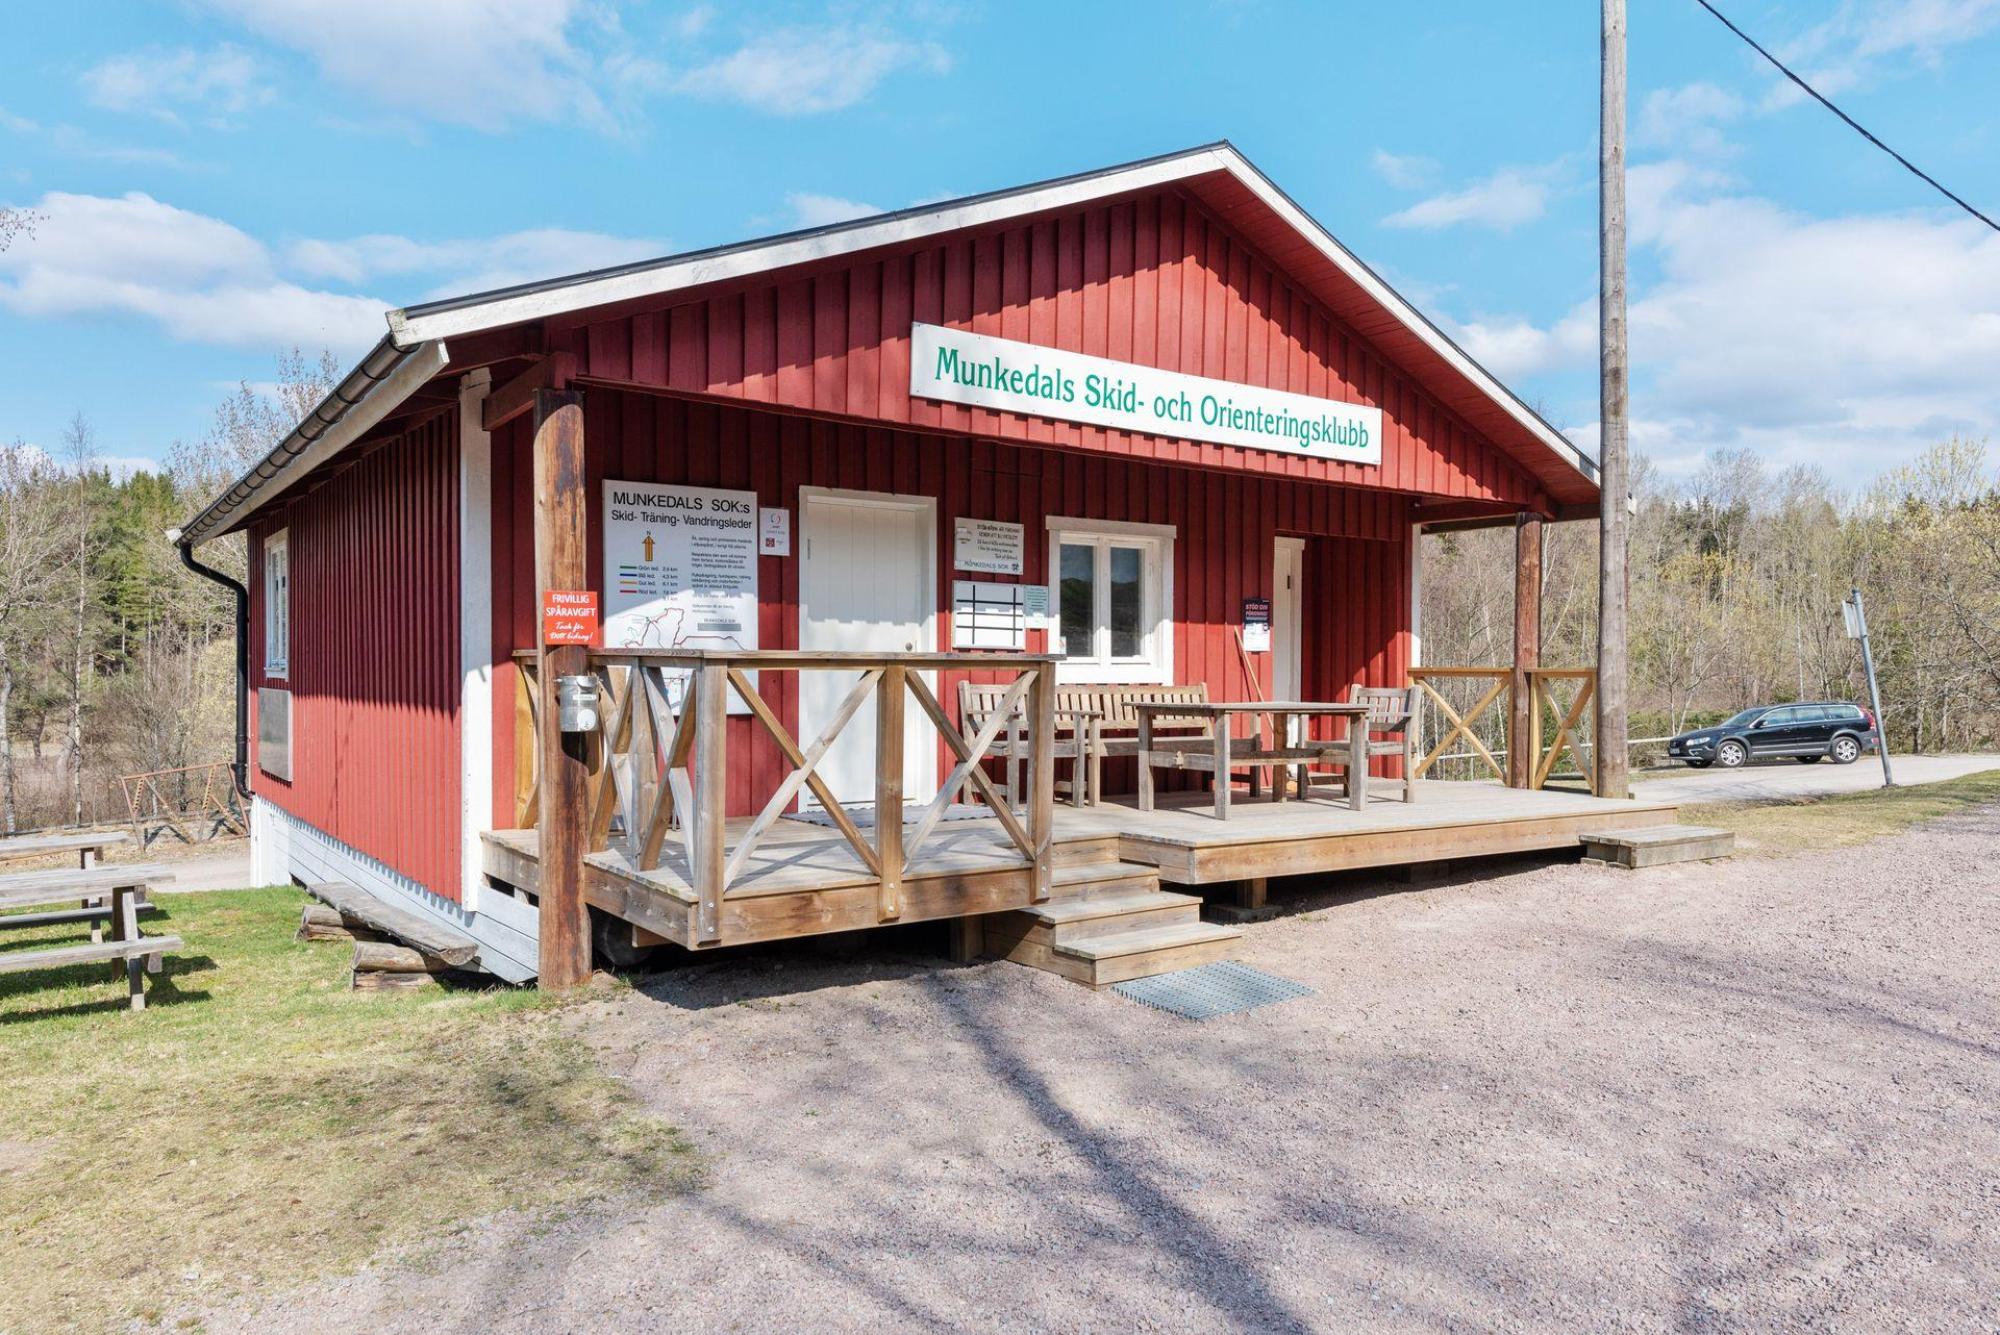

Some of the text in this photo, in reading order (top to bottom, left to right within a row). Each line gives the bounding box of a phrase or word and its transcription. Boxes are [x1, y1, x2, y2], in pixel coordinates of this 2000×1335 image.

[934, 346, 1369, 448] Munkedals Skid- och Orienteringsklubb
[613, 491, 751, 514] MUNKEDALS SOK:s
[611, 509, 752, 530] Skid- Träning- Vandringsleder
[552, 594, 590, 604] FRIVILLIG
